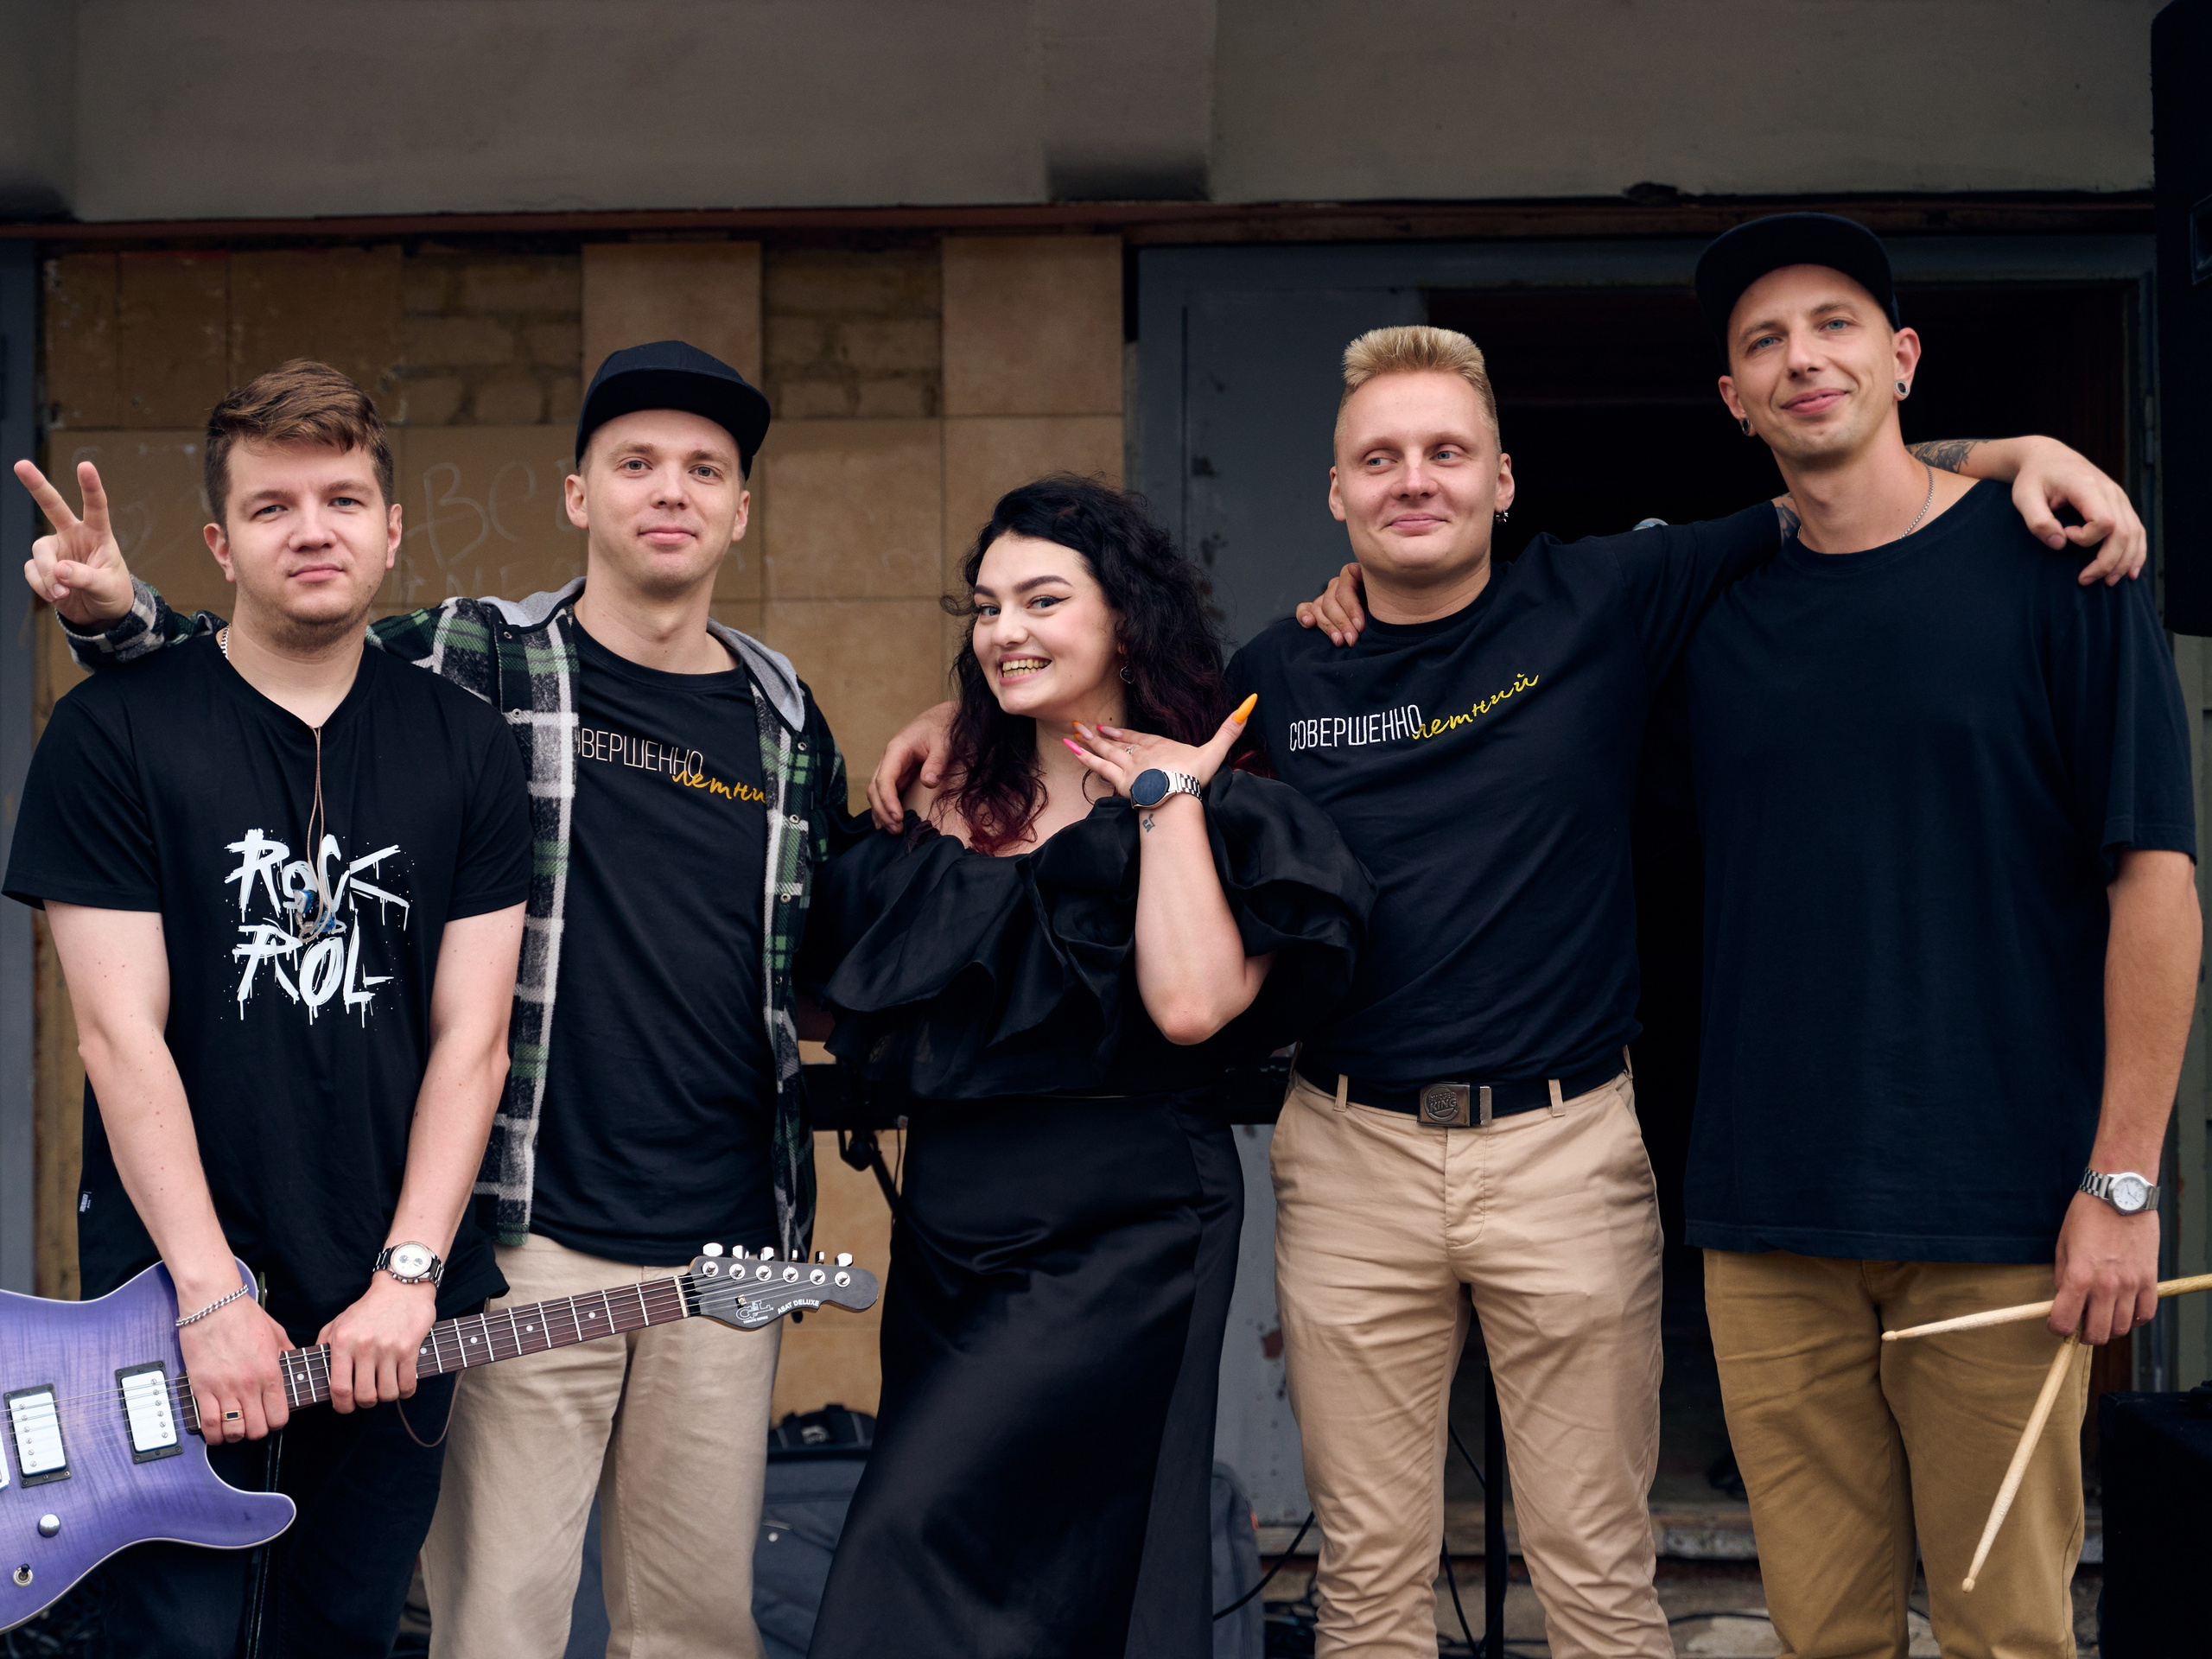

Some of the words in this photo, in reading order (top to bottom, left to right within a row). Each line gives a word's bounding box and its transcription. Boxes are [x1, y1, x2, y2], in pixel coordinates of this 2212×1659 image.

[577, 728, 703, 779] ВЕРШЕННО
[1428, 1091, 1457, 1104] BURGER
[1429, 1097, 1457, 1112] KING
[792, 1299, 820, 1308] DELUXE
